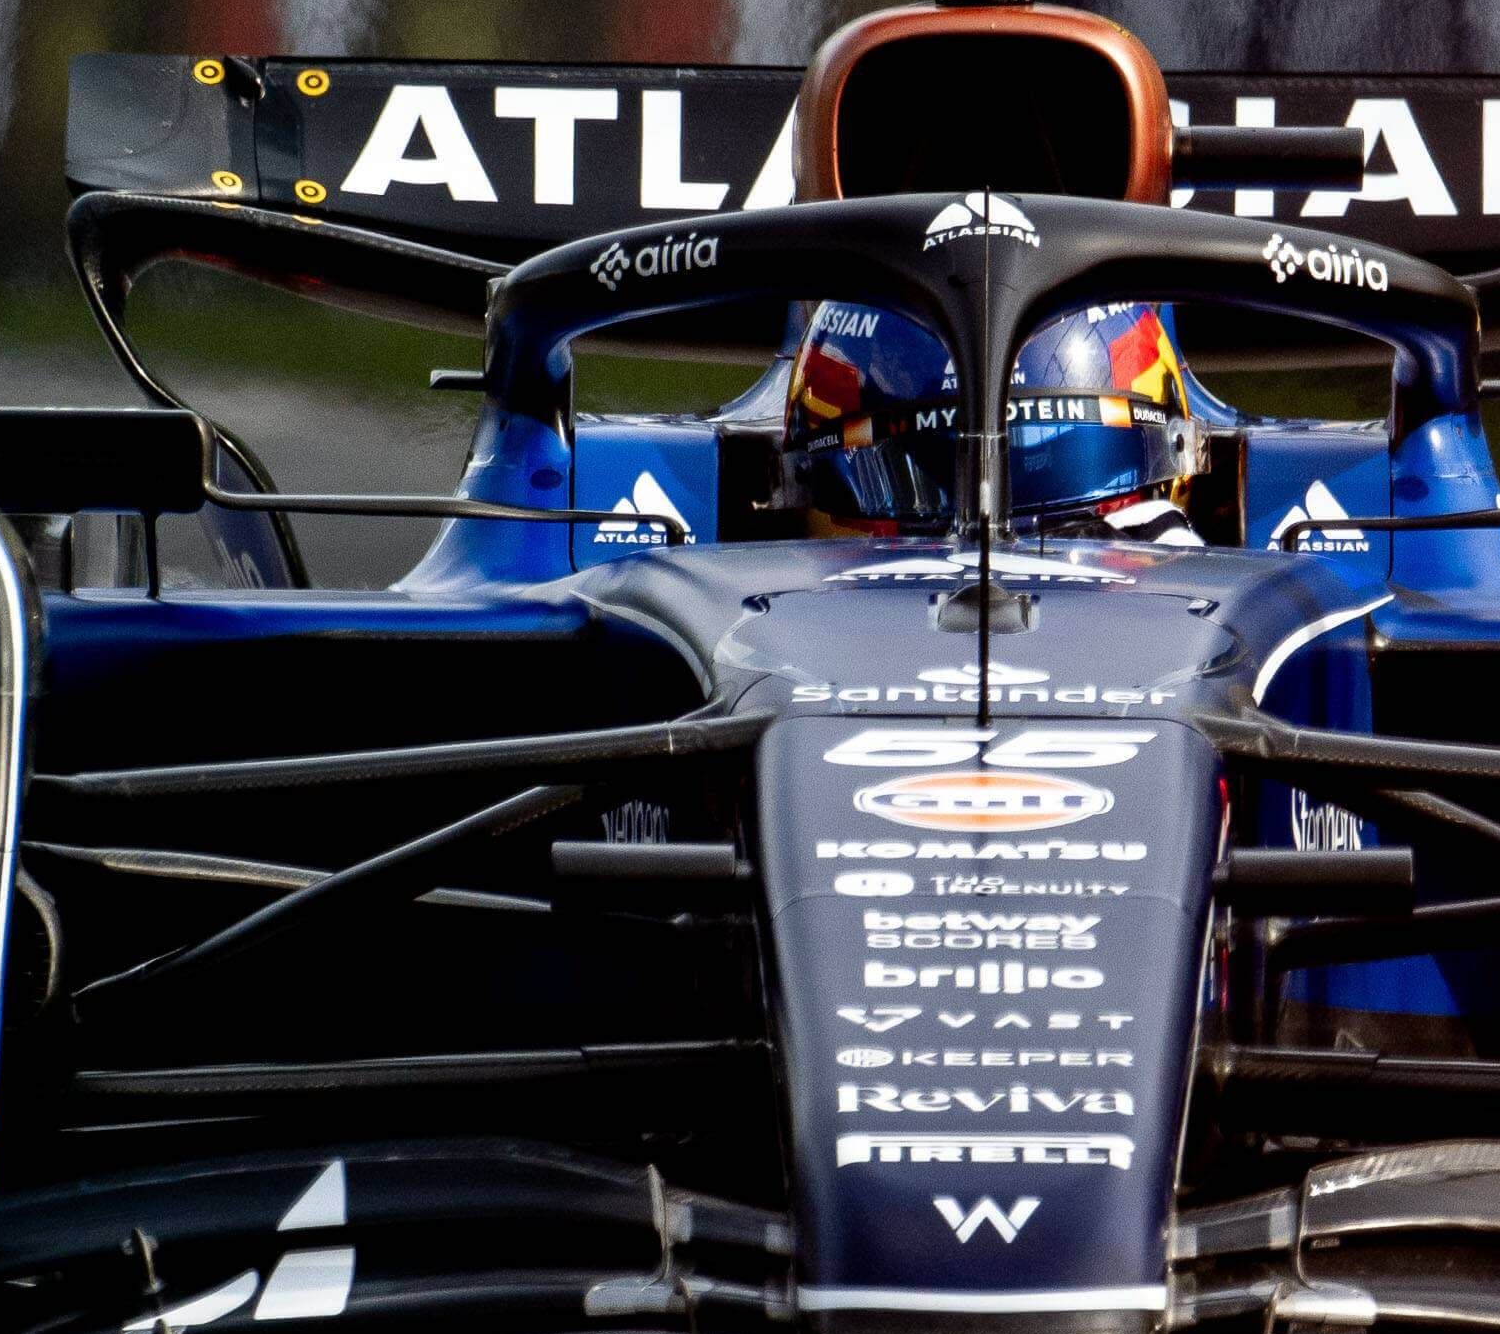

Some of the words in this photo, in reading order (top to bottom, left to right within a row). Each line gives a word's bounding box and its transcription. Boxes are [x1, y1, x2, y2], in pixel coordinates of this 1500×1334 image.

[923, 226, 1040, 251] ATLASSIAN
[635, 232, 718, 277] airia
[1307, 244, 1388, 291] airia
[819, 306, 879, 338] SSIAN
[916, 398, 1085, 431] MYOTEIN
[594, 533, 696, 544] ATLASSIN
[1267, 540, 1369, 552] AASSIAN
[791, 683, 1177, 706] Santander
[815, 840, 1148, 861] KOMATSU
[862, 910, 1102, 934] betway
[866, 932, 1098, 950] SCORES
[864, 961, 1105, 994] brillio
[937, 1013, 1135, 1030] VAST
[901, 1051, 1135, 1067] KEEPER
[836, 1084, 1135, 1116] Reviva
[836, 1133, 1135, 1170] PIRELLI
[932, 1196, 1042, 1245] W
